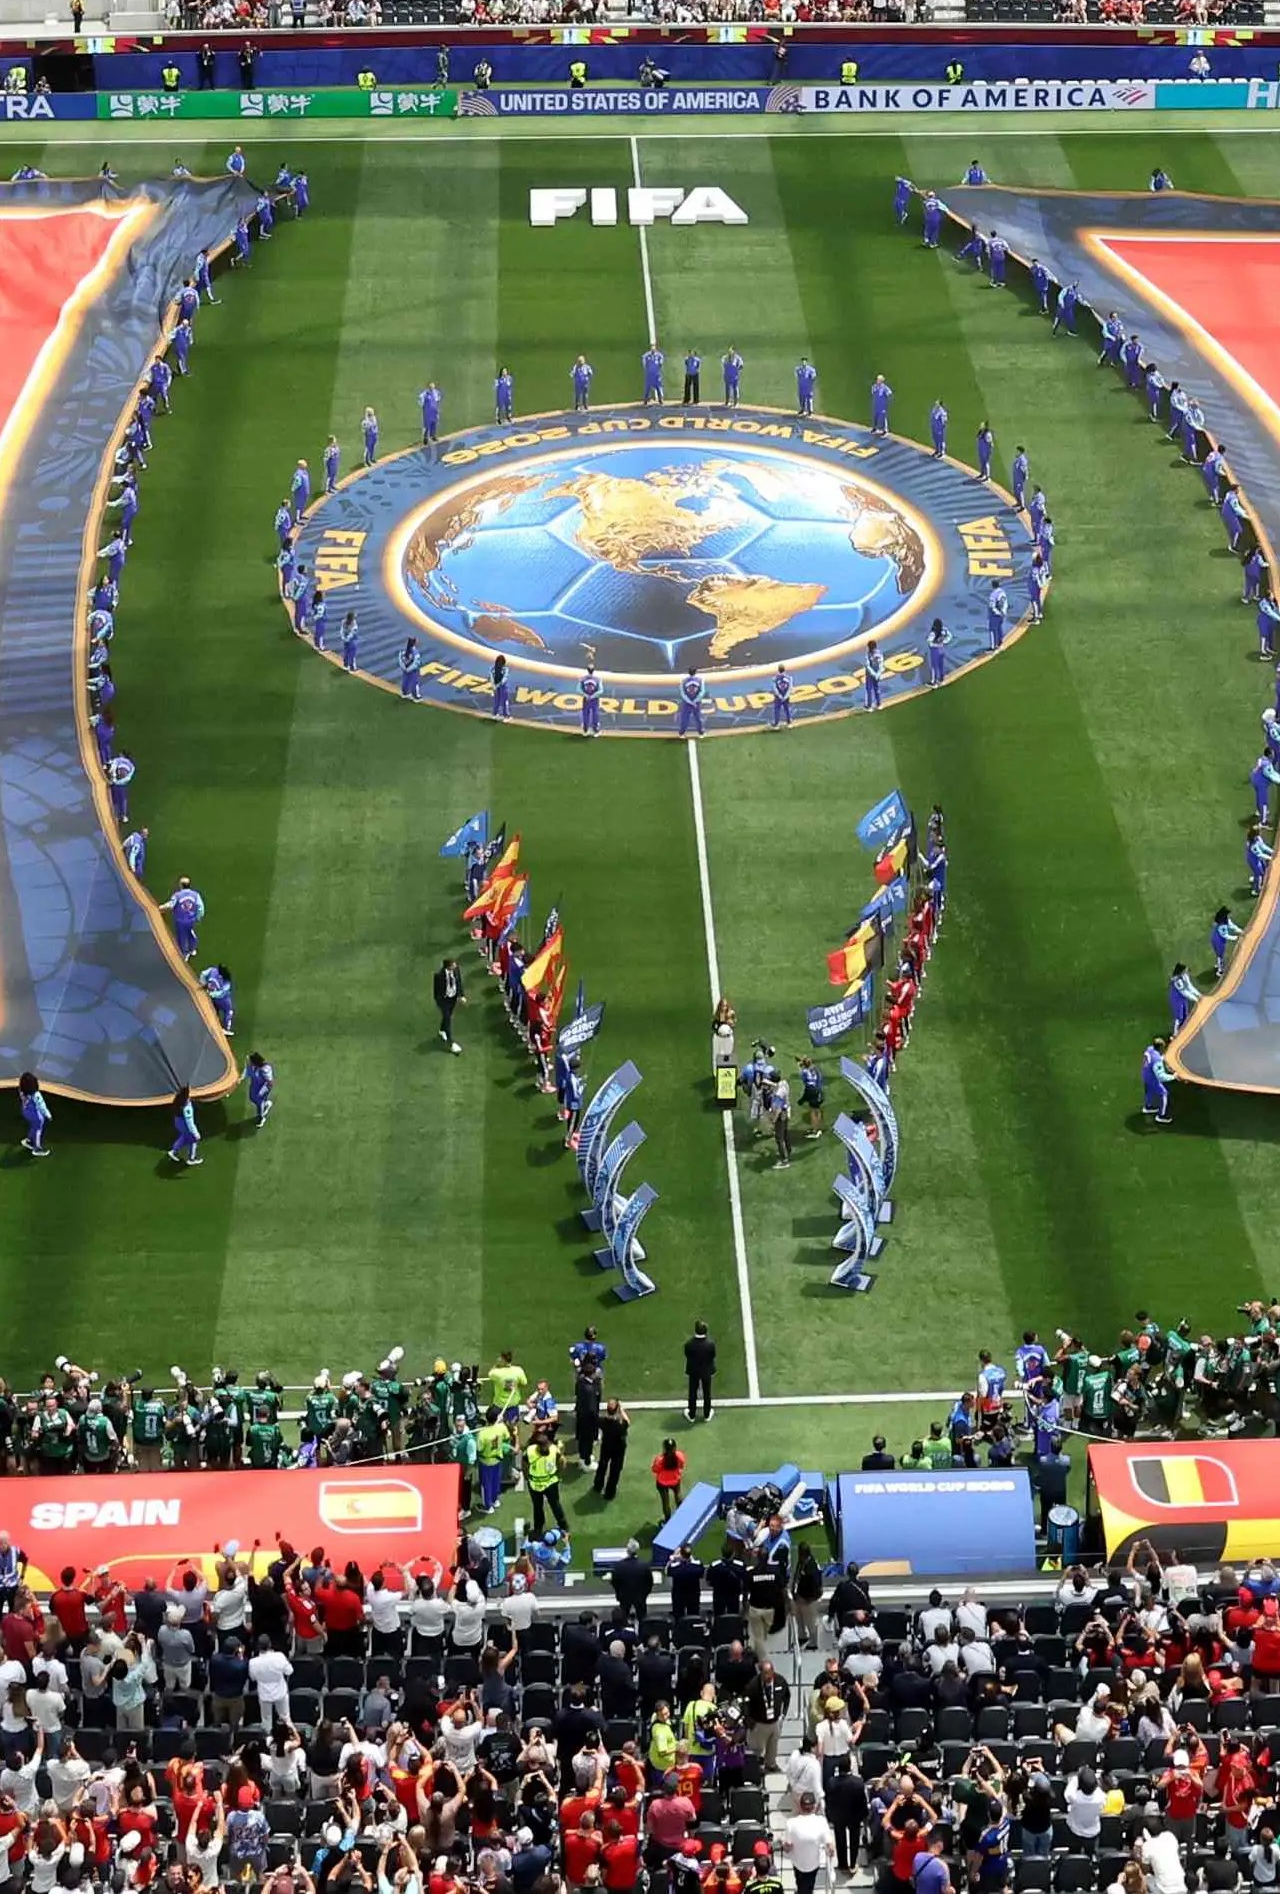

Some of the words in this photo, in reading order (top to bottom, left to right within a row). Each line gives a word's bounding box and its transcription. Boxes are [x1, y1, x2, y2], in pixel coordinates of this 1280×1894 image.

[500, 92, 568, 112] UNITED
[571, 92, 643, 111] STATES
[646, 92, 669, 110] OF
[672, 91, 760, 110] AMERICA
[814, 88, 903, 109] BANK
[912, 87, 952, 108] OF
[960, 86, 1108, 108] AMERICA
[529, 186, 749, 226] FIFA
[577, 417, 651, 435] CUP
[658, 417, 793, 439] WORLD
[440, 425, 572, 467] 2026
[800, 428, 879, 459] FIFA
[314, 529, 366, 592] FIFA
[956, 515, 1012, 577] FIFA
[419, 661, 494, 695] FIFA
[515, 686, 679, 715] WORLD
[854, 1482, 885, 1494] FIFA
[885, 1481, 936, 1493] WORLD
[30, 1498, 180, 1531] SPAIN
